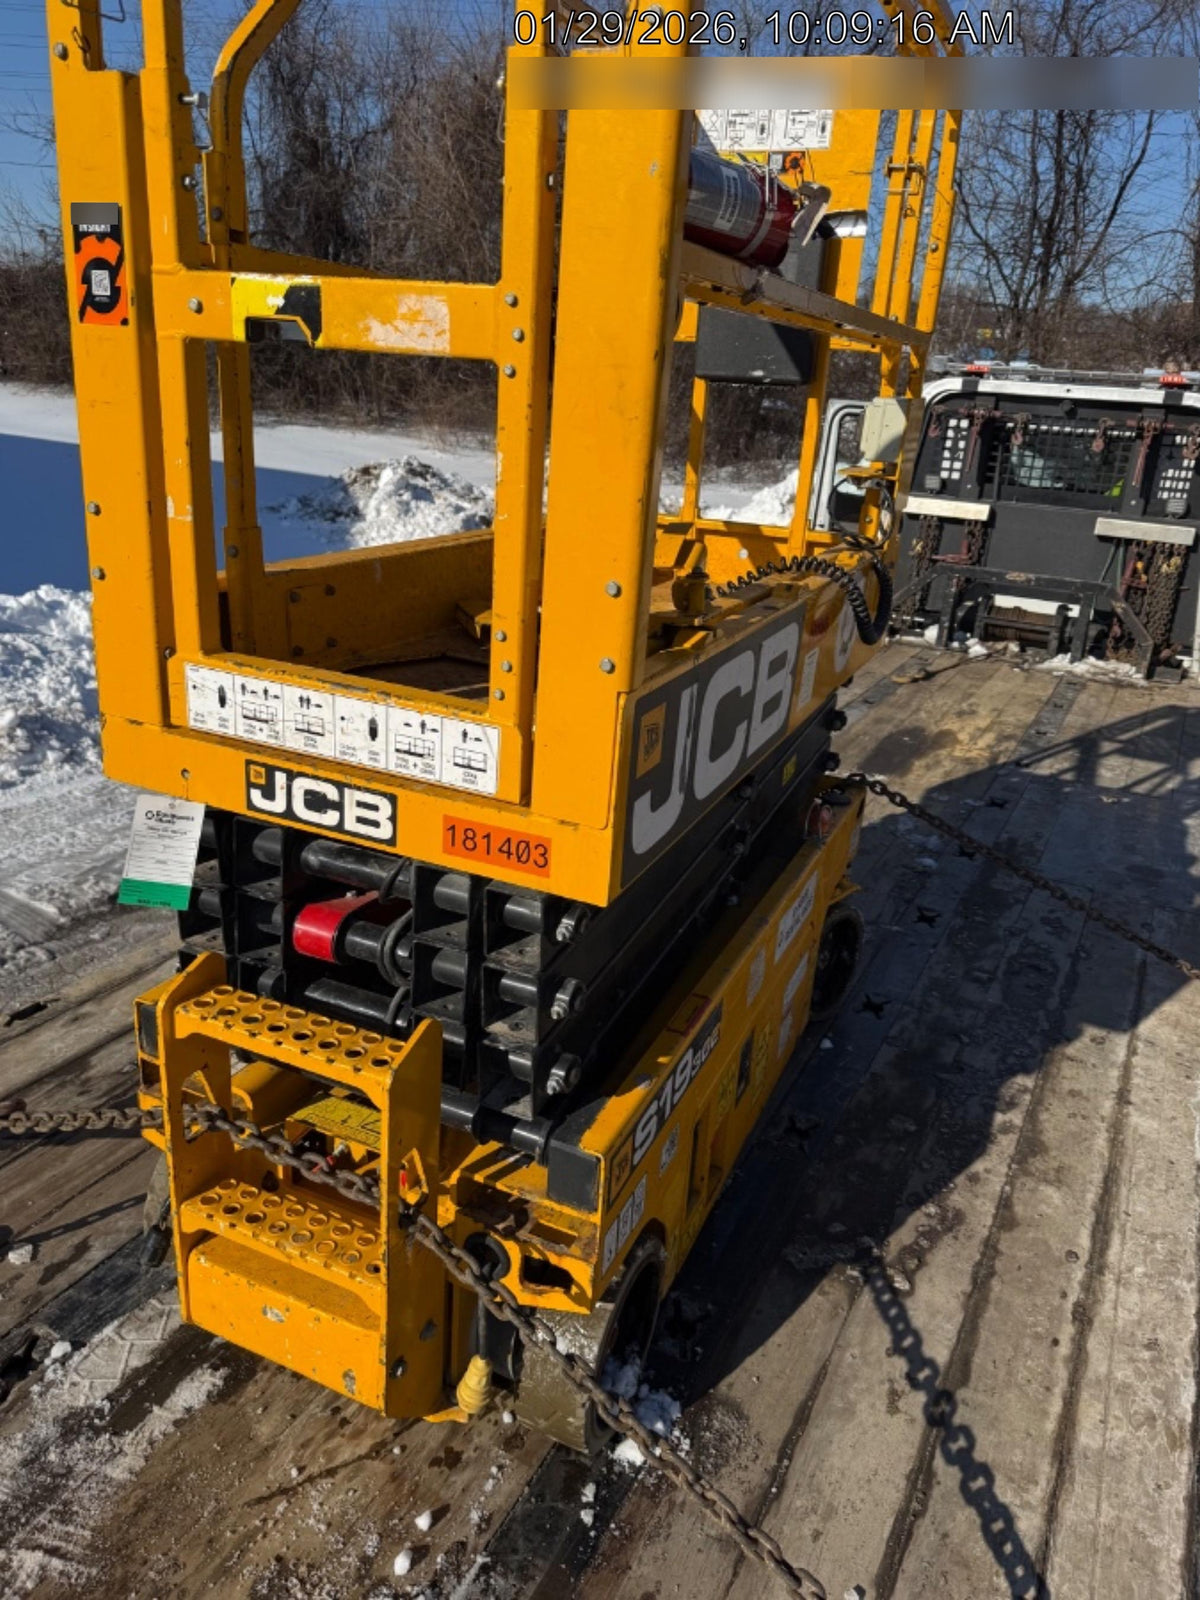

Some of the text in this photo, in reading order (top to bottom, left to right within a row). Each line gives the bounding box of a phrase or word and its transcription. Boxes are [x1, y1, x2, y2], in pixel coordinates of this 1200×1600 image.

[632, 622, 799, 855] JCB
[249, 770, 394, 841] JCB
[446, 824, 549, 869] 181403
